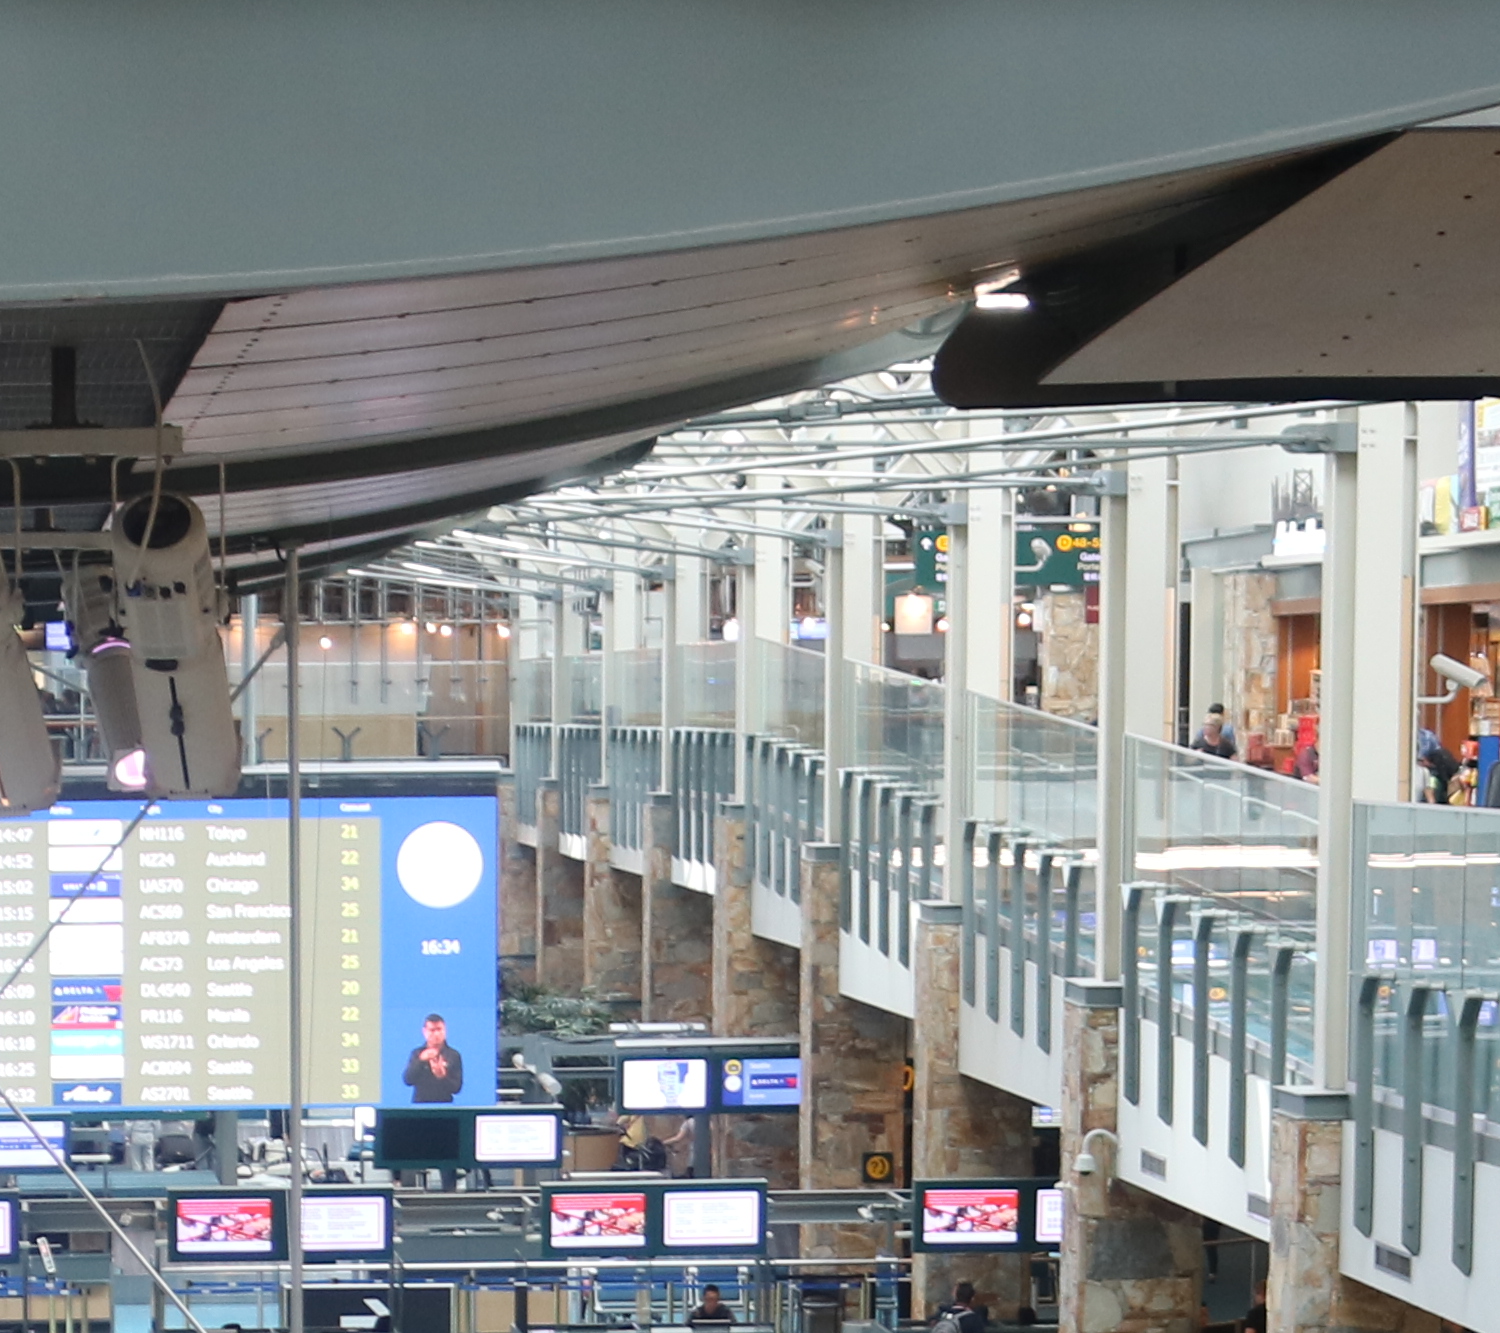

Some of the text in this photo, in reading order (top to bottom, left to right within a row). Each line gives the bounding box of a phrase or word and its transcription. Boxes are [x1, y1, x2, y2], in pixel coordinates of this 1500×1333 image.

[139, 827, 185, 841] NH116
[206, 826, 247, 842] Tokyo
[341, 824, 358, 839] 21
[140, 853, 175, 867] NZ24
[206, 852, 266, 867] Auckland
[341, 850, 359, 865] 22
[206, 878, 259, 894] Chicago
[341, 877, 359, 890] 34
[207, 904, 231, 918] San
[341, 903, 359, 917] 25
[207, 930, 281, 944] Amsterdam
[341, 929, 359, 943] 21
[421, 940, 460, 955] 16:34
[207, 956, 228, 970] Los
[233, 956, 284, 972] Angeles
[341, 955, 360, 969] 25
[207, 983, 253, 997] Seattle
[341, 981, 360, 995] 20
[207, 1009, 250, 1022] Manila
[342, 1007, 360, 1021] 22
[207, 1035, 260, 1048] Orlando
[342, 1033, 360, 1047] 34
[207, 1060, 253, 1074] Seattle
[342, 1059, 360, 1073] 33
[207, 1086, 253, 1100] Seattle
[342, 1085, 360, 1099] 33
